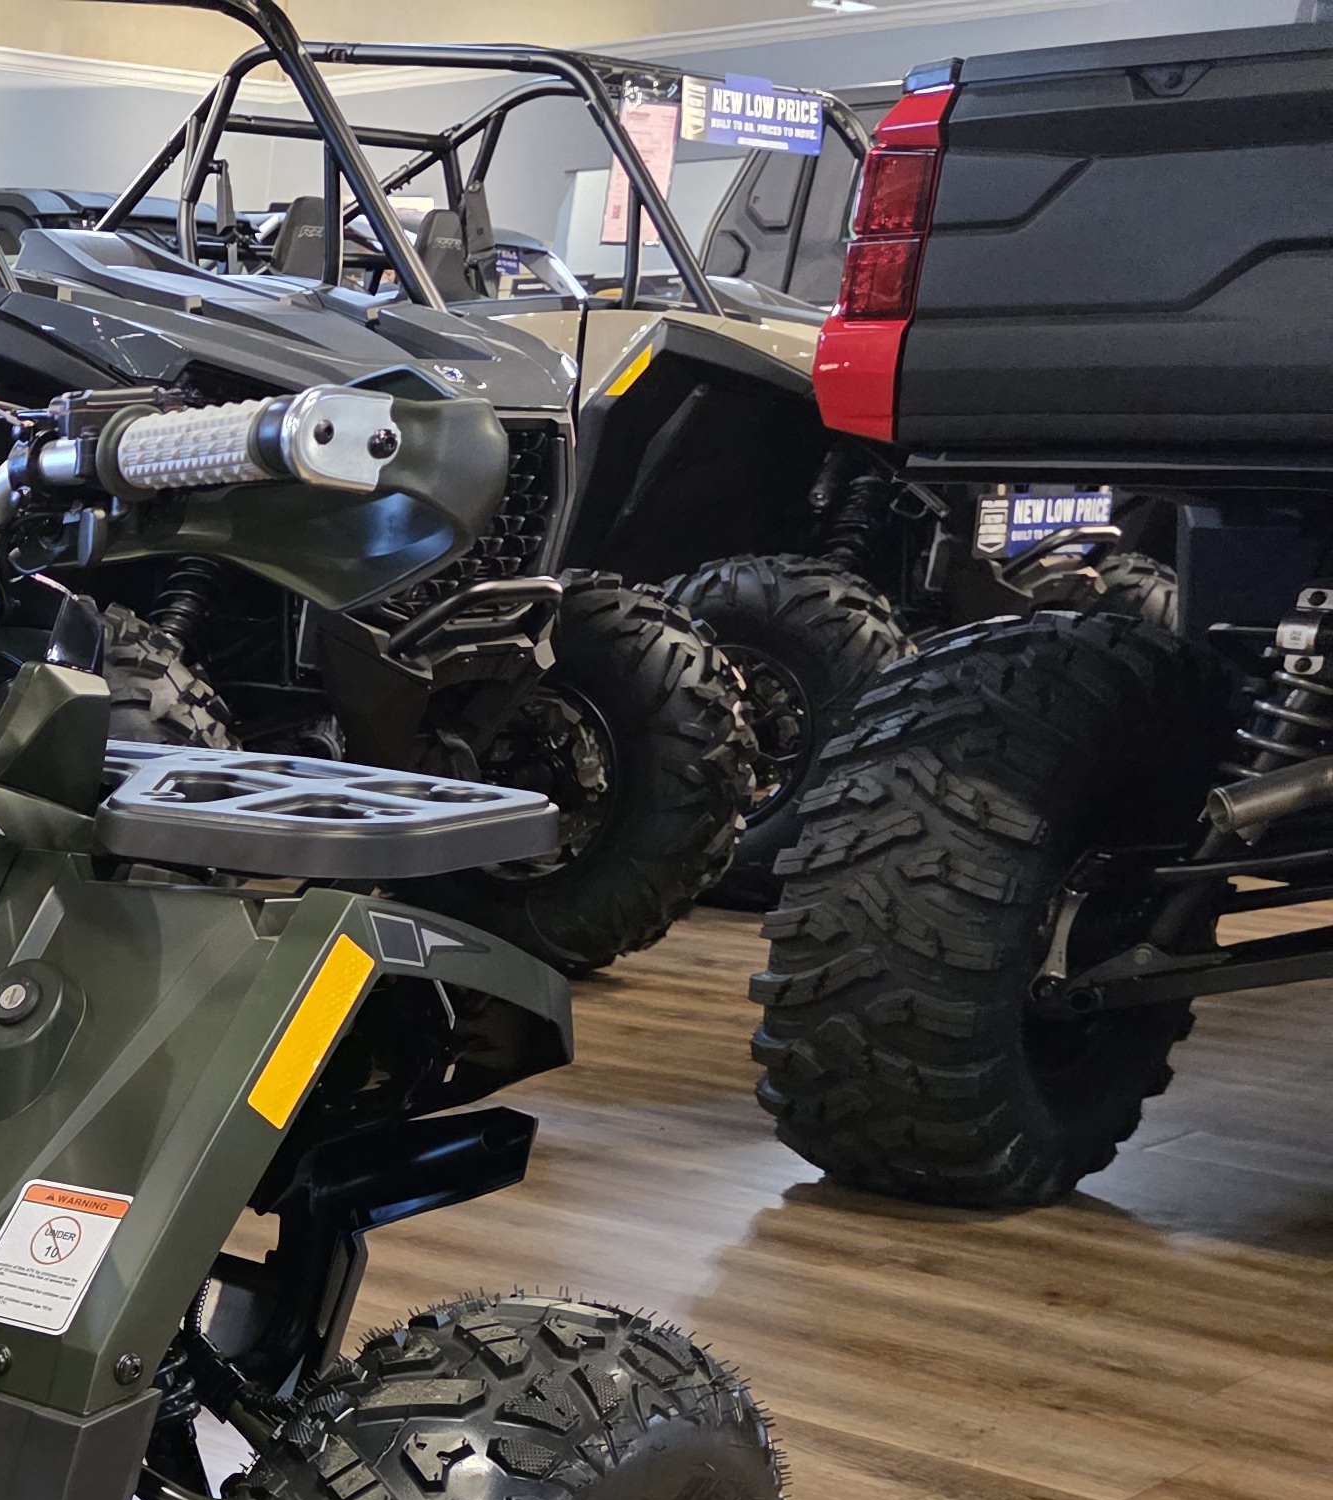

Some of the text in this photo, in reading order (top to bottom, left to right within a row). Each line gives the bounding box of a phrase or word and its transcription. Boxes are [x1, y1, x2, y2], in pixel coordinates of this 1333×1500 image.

[712, 88, 744, 115] NEW
[745, 93, 775, 119] LOW
[777, 97, 819, 124] PRICE
[298, 225, 325, 239] RZ
[1013, 499, 1046, 524] NEW
[1046, 498, 1076, 523] LOW
[1075, 497, 1110, 523] PRICE
[58, 1194, 109, 1211] WARNING
[44, 1227, 77, 1242] UNDER
[44, 1246, 60, 1259] 10
